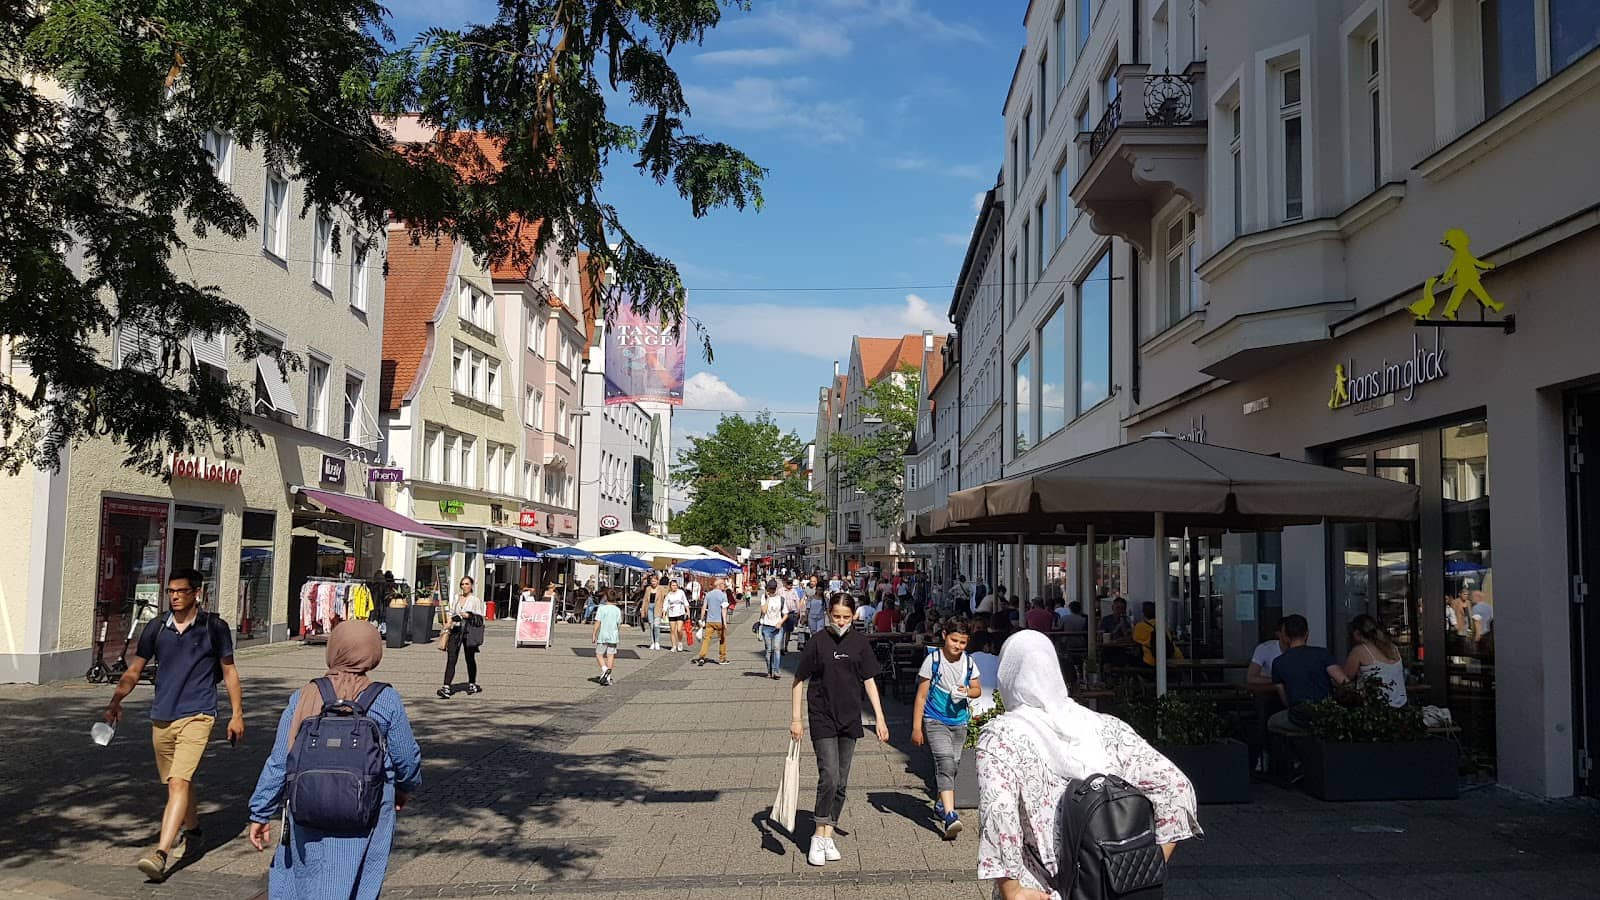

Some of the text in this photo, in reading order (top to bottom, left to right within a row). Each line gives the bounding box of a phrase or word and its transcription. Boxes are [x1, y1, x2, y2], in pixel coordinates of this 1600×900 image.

[617, 325, 673, 336] TANZ
[617, 335, 673, 346] TAGE
[1348, 326, 1446, 406] hans im glück
[169, 452, 242, 485] Foot Locker
[372, 470, 399, 482] liberty
[520, 611, 548, 624] SALE
